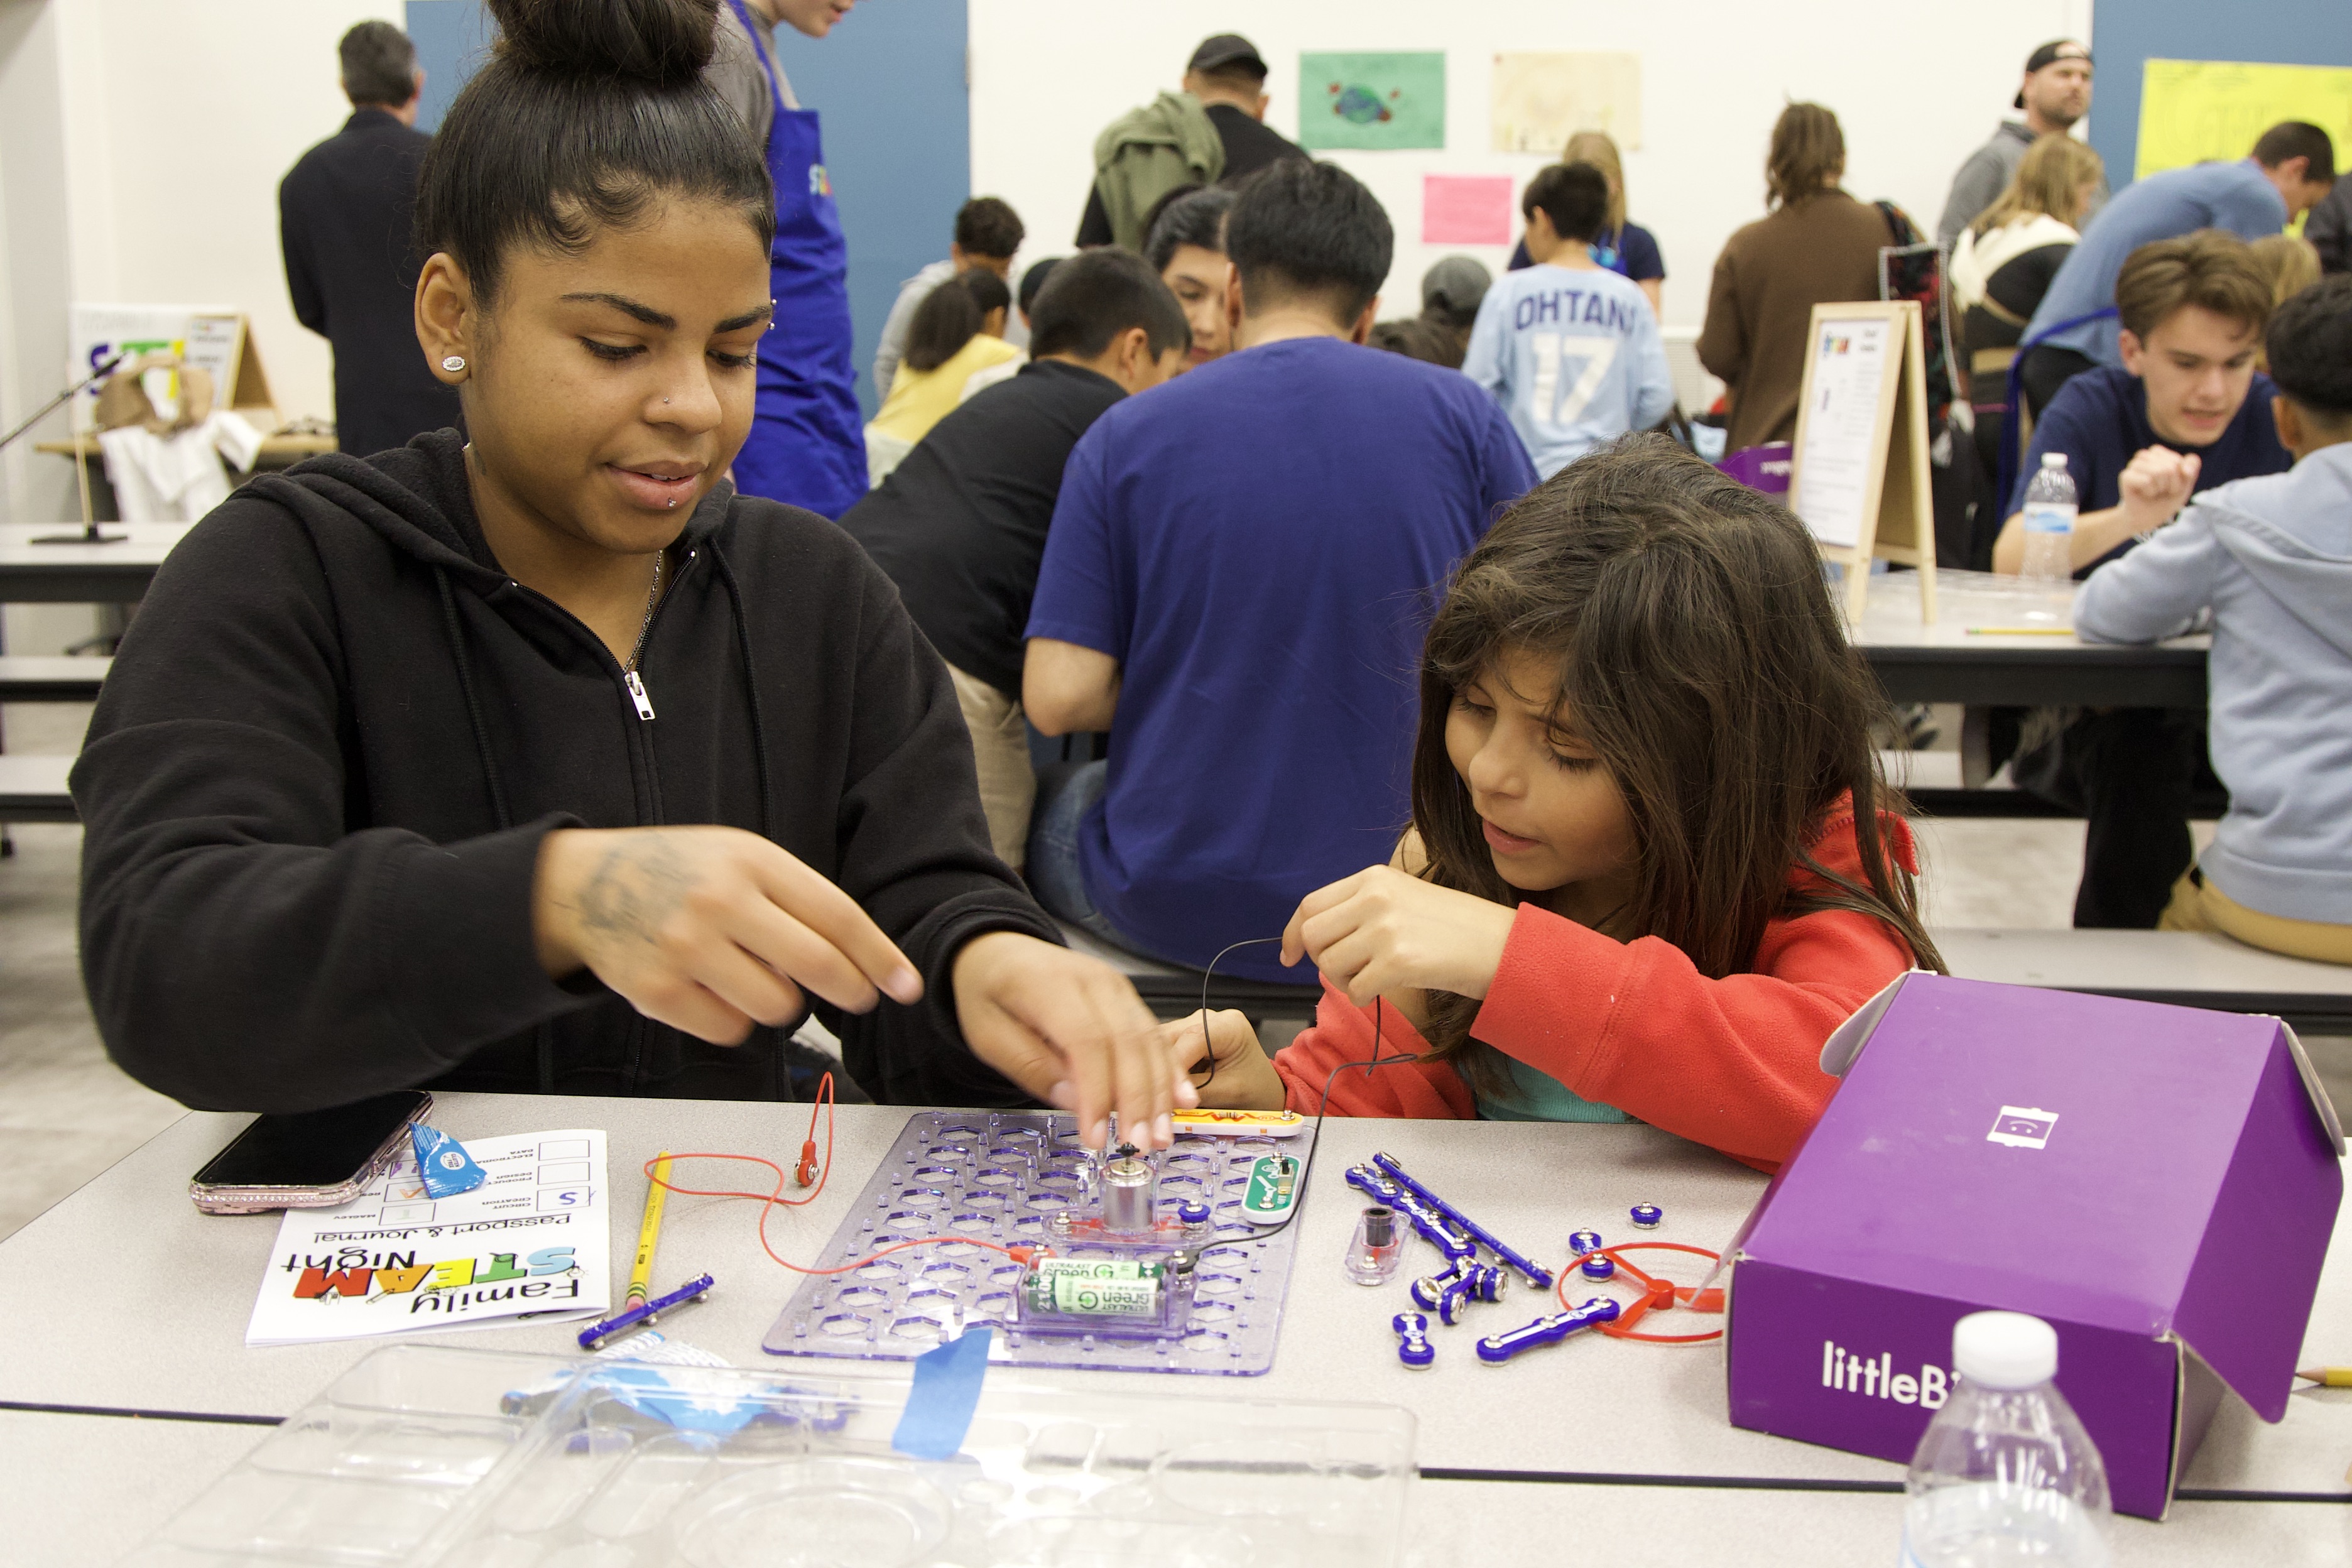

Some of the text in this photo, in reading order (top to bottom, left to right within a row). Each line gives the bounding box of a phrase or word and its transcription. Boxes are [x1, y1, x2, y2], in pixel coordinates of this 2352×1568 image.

[1532, 333, 1619, 425] 17
[315, 1215, 570, 1244] Passport & Journal
[281, 1246, 415, 1278] Night
[292, 1247, 576, 1298] STEAM
[410, 1279, 579, 1314] Family
[1038, 1275, 1052, 1310] 2100
[1103, 1292, 1149, 1305] Green
